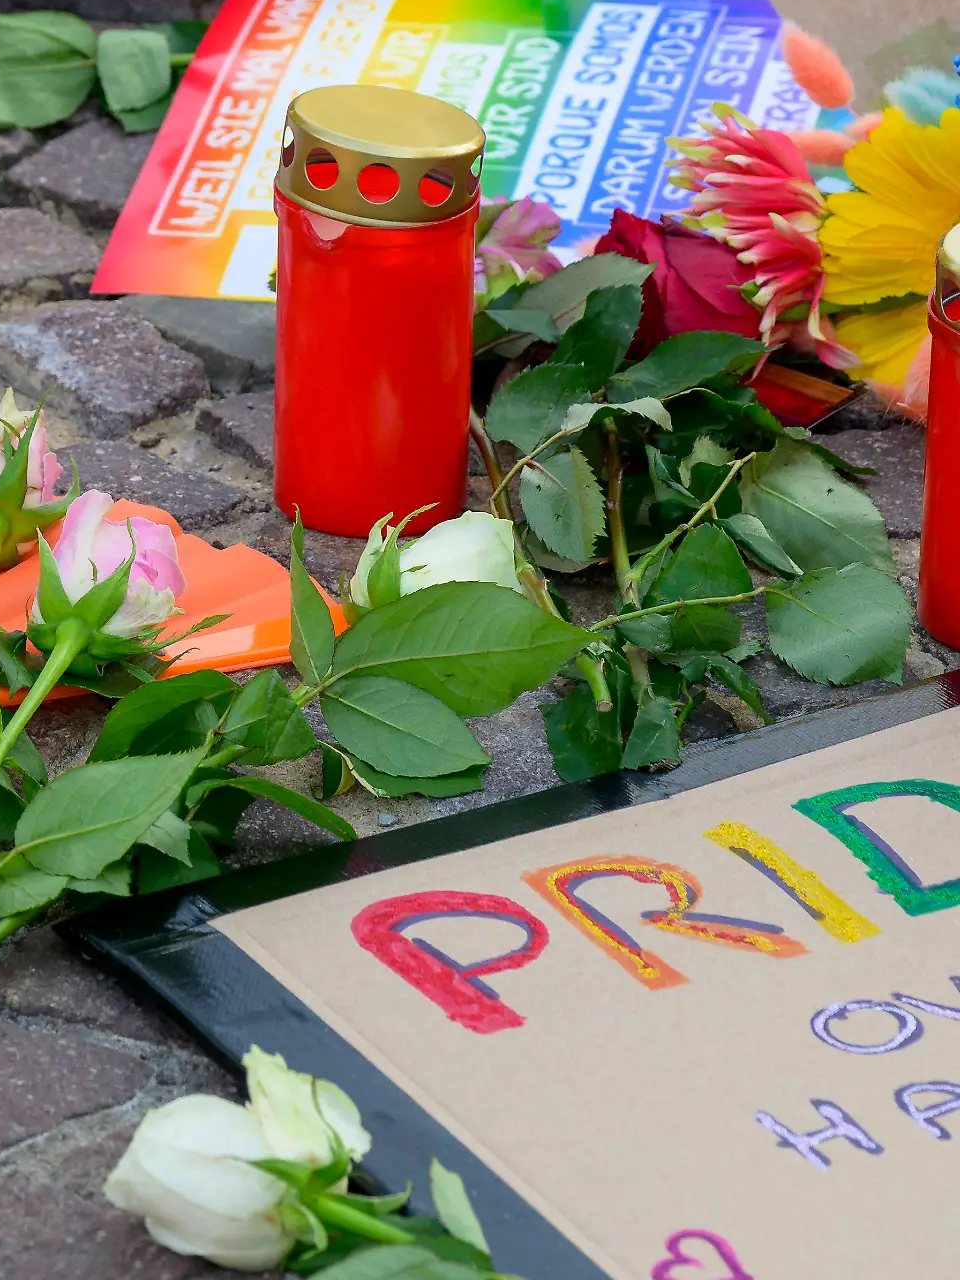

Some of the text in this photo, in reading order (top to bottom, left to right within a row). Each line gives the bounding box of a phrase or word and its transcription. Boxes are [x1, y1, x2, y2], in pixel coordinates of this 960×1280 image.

[231, 43, 295, 92] MAL
[370, 29, 434, 78] WIR
[703, 24, 766, 88] SEIN
[205, 95, 268, 150] SIE
[484, 35, 562, 160] WIR SIND
[527, 6, 647, 211] PORQUE SOMOS
[591, 119, 665, 216] DARUM
[628, 8, 711, 114] WERDEN
[169, 153, 244, 227] WEIL
